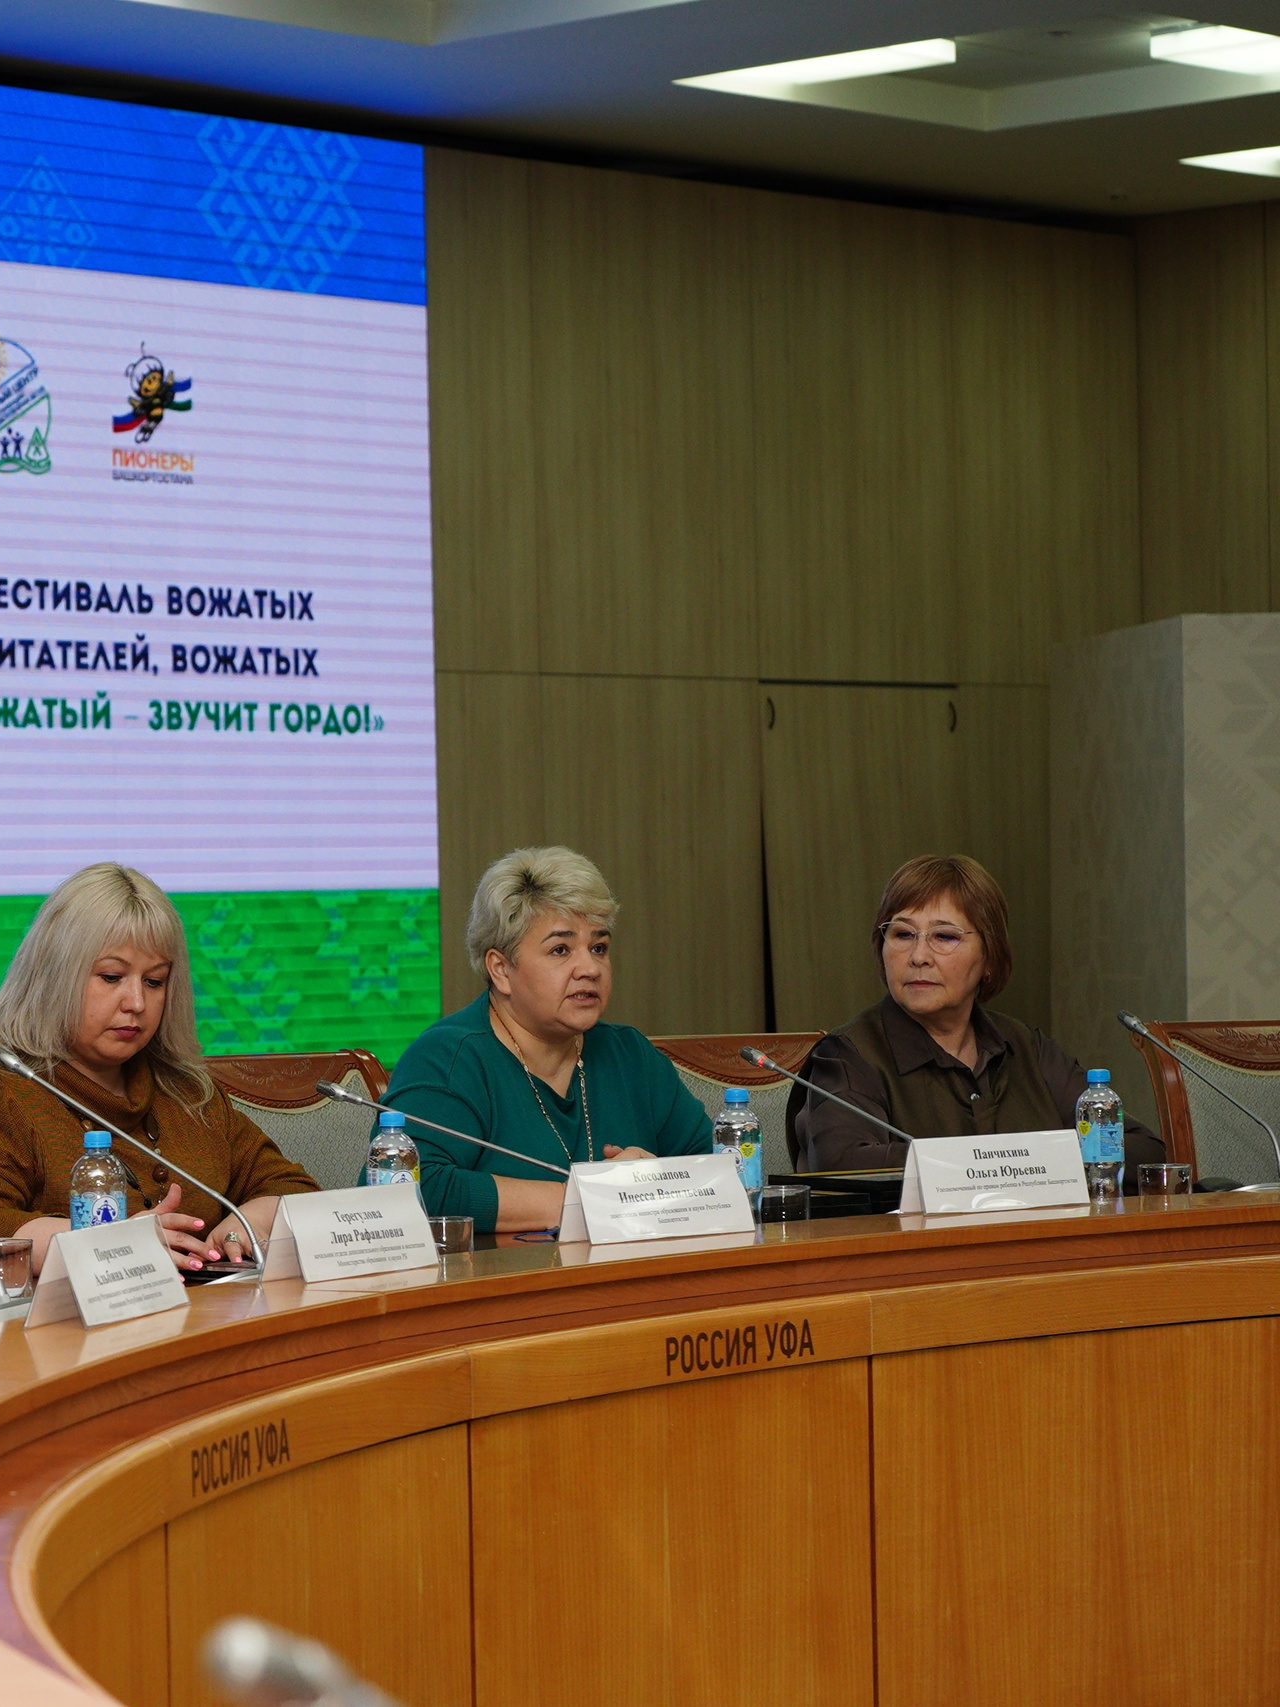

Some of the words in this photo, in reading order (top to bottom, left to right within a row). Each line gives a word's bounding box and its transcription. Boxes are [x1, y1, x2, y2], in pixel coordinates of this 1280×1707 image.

[112, 448, 194, 472] ПИОНЕРЫ
[167, 585, 315, 621] ВОЖАТЫХ
[171, 643, 319, 677] ВОЖАТЫХ
[148, 700, 259, 732] ЗВУЧИТ
[268, 702, 385, 736] ГОРДО!»
[972, 1148, 1030, 1160] Панчихина
[632, 1169, 691, 1183] Косолапова
[966, 1167, 998, 1180] Ольга
[999, 1164, 1047, 1179] Юрьевна
[618, 1191, 656, 1204] Инесса
[656, 1186, 716, 1201] Васильевна
[333, 1209, 384, 1225] Терегулова
[330, 1231, 354, 1247] Лира
[353, 1228, 405, 1244] Рафаиловна
[665, 1325, 757, 1377] РОССИЯ
[764, 1318, 815, 1362] УФА
[190, 1430, 251, 1498] РОССИЯ
[254, 1418, 291, 1472] УФА
